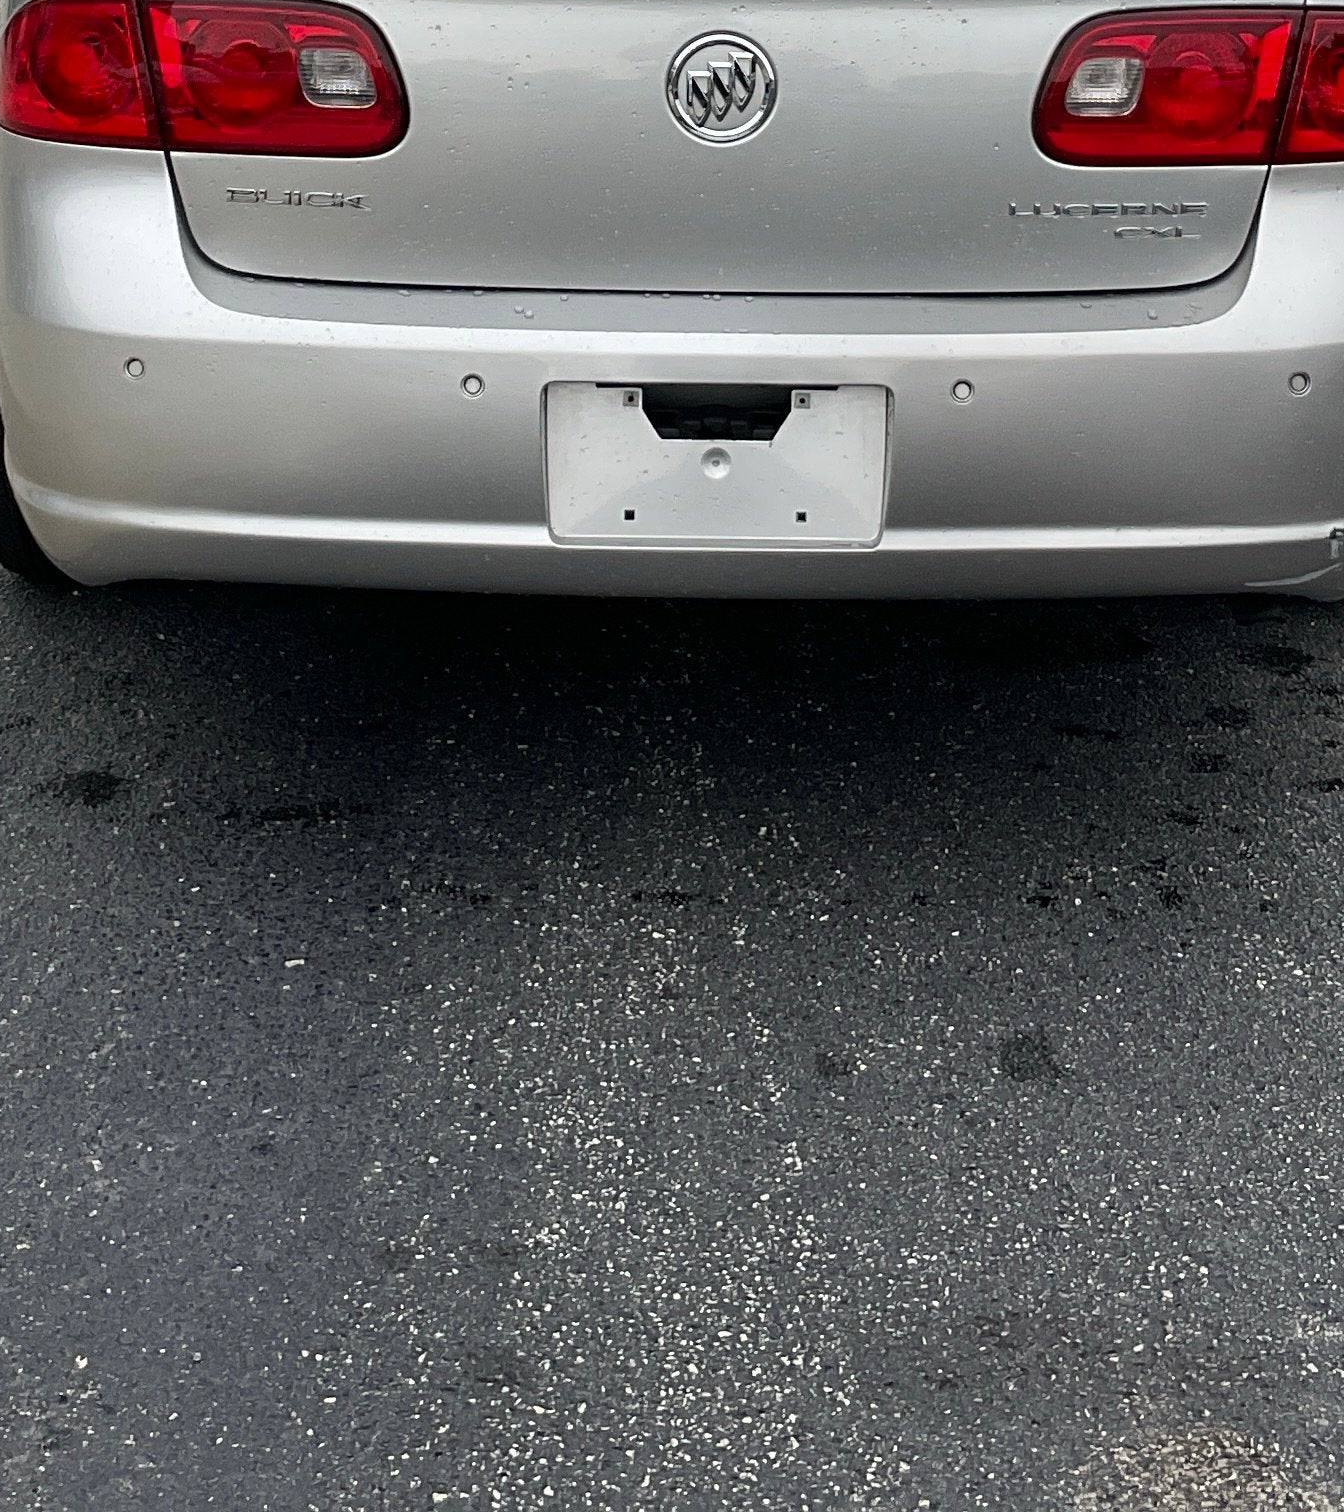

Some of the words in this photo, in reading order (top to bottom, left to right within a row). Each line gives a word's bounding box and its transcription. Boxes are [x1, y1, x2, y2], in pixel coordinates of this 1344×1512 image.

[225, 187, 373, 212] BUICK
[1008, 202, 1209, 219] LUCERNE
[1113, 225, 1202, 239] CXL
